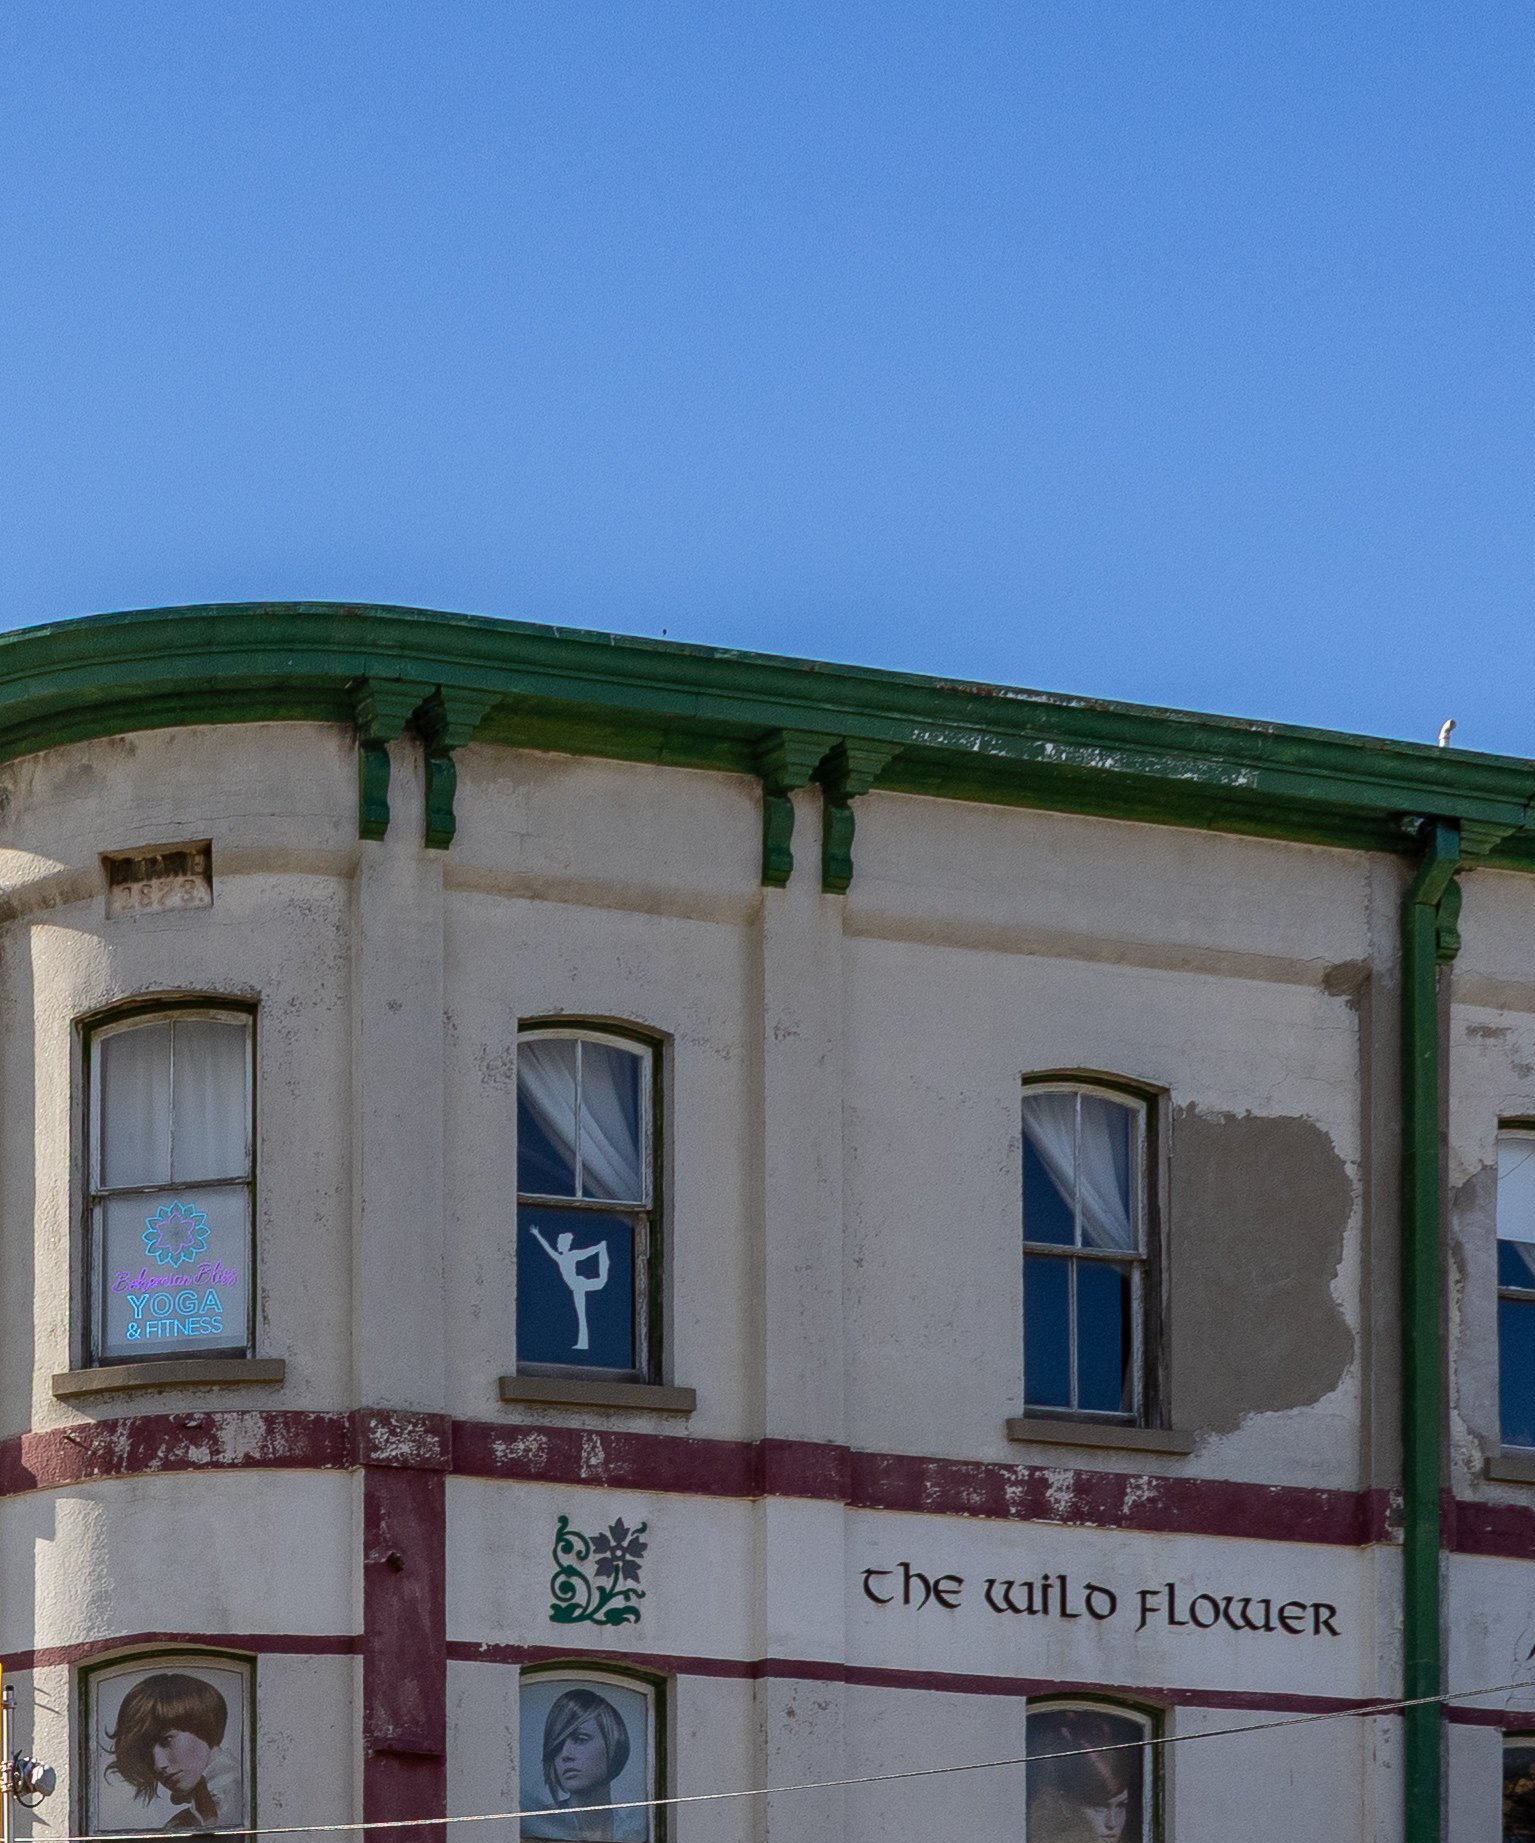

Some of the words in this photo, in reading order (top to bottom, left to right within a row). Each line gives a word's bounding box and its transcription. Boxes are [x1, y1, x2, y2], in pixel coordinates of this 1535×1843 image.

[112, 1267, 191, 1293] Bohemian
[194, 1259, 238, 1287] Bliss
[127, 1288, 223, 1319] YOGA
[126, 1322, 141, 1340] &
[146, 1315, 224, 1338] FITNESS
